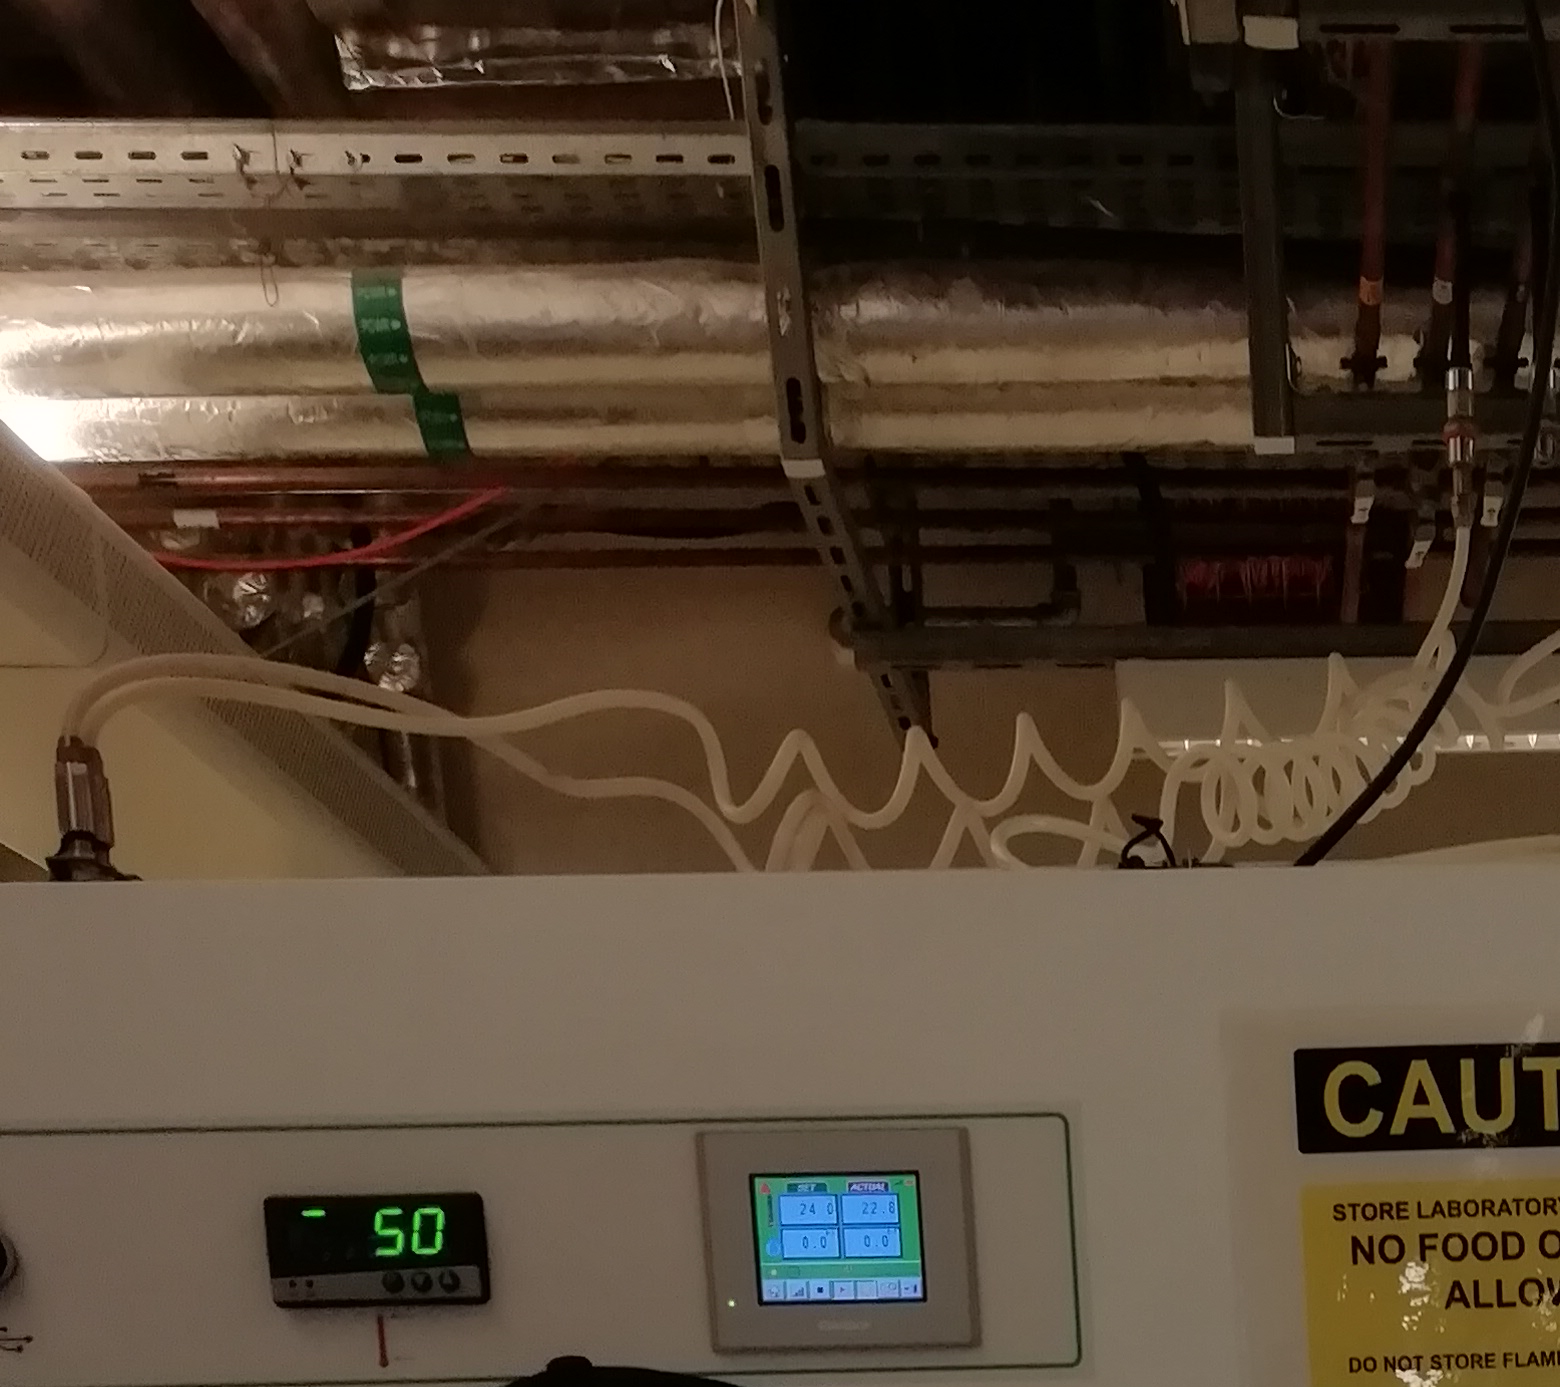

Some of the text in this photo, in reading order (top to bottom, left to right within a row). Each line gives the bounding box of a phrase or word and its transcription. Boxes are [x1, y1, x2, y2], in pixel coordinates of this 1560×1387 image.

[850, 1181, 887, 1192] ACTUAL
[1333, 1201, 1410, 1222] STORE
[373, 1206, 445, 1257] 50
[1350, 1233, 1406, 1265] NO
[1418, 1231, 1526, 1262] FOOD
[1349, 1356, 1378, 1373] DO
[1383, 1355, 1424, 1373] NOT
[1430, 1352, 1497, 1371] STORE
